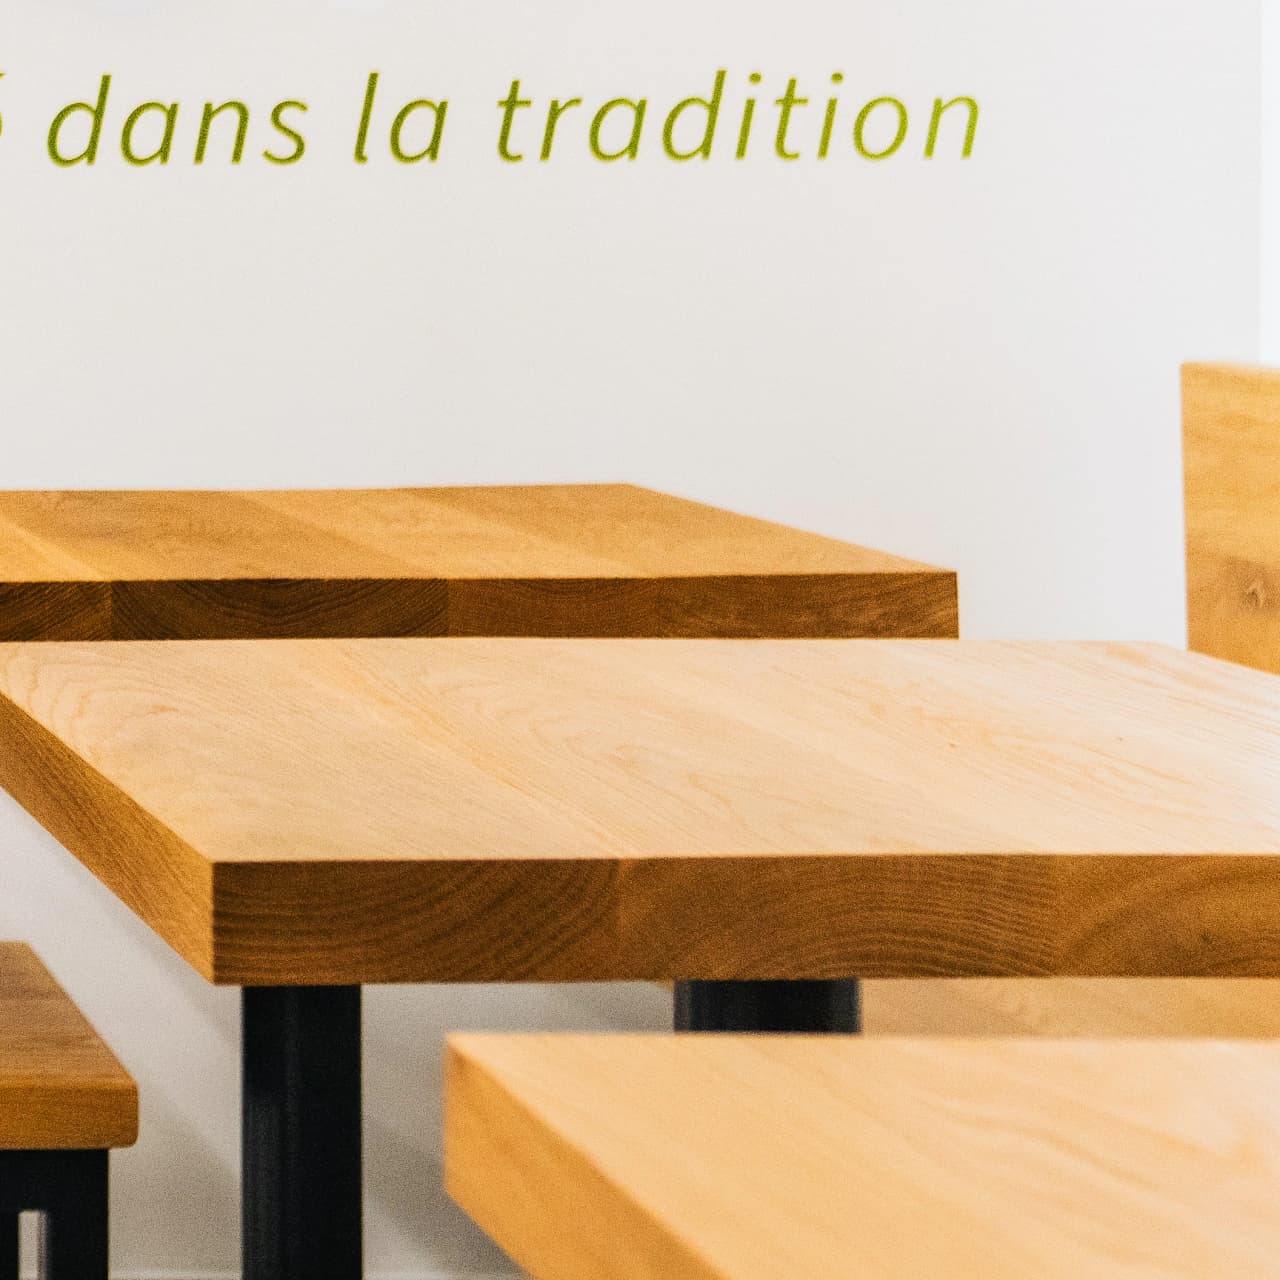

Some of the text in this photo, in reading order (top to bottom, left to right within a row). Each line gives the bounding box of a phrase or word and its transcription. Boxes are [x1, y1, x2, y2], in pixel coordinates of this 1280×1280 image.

[46, 73, 310, 168] dans
[353, 70, 449, 165] la
[496, 68, 980, 164] tradition
